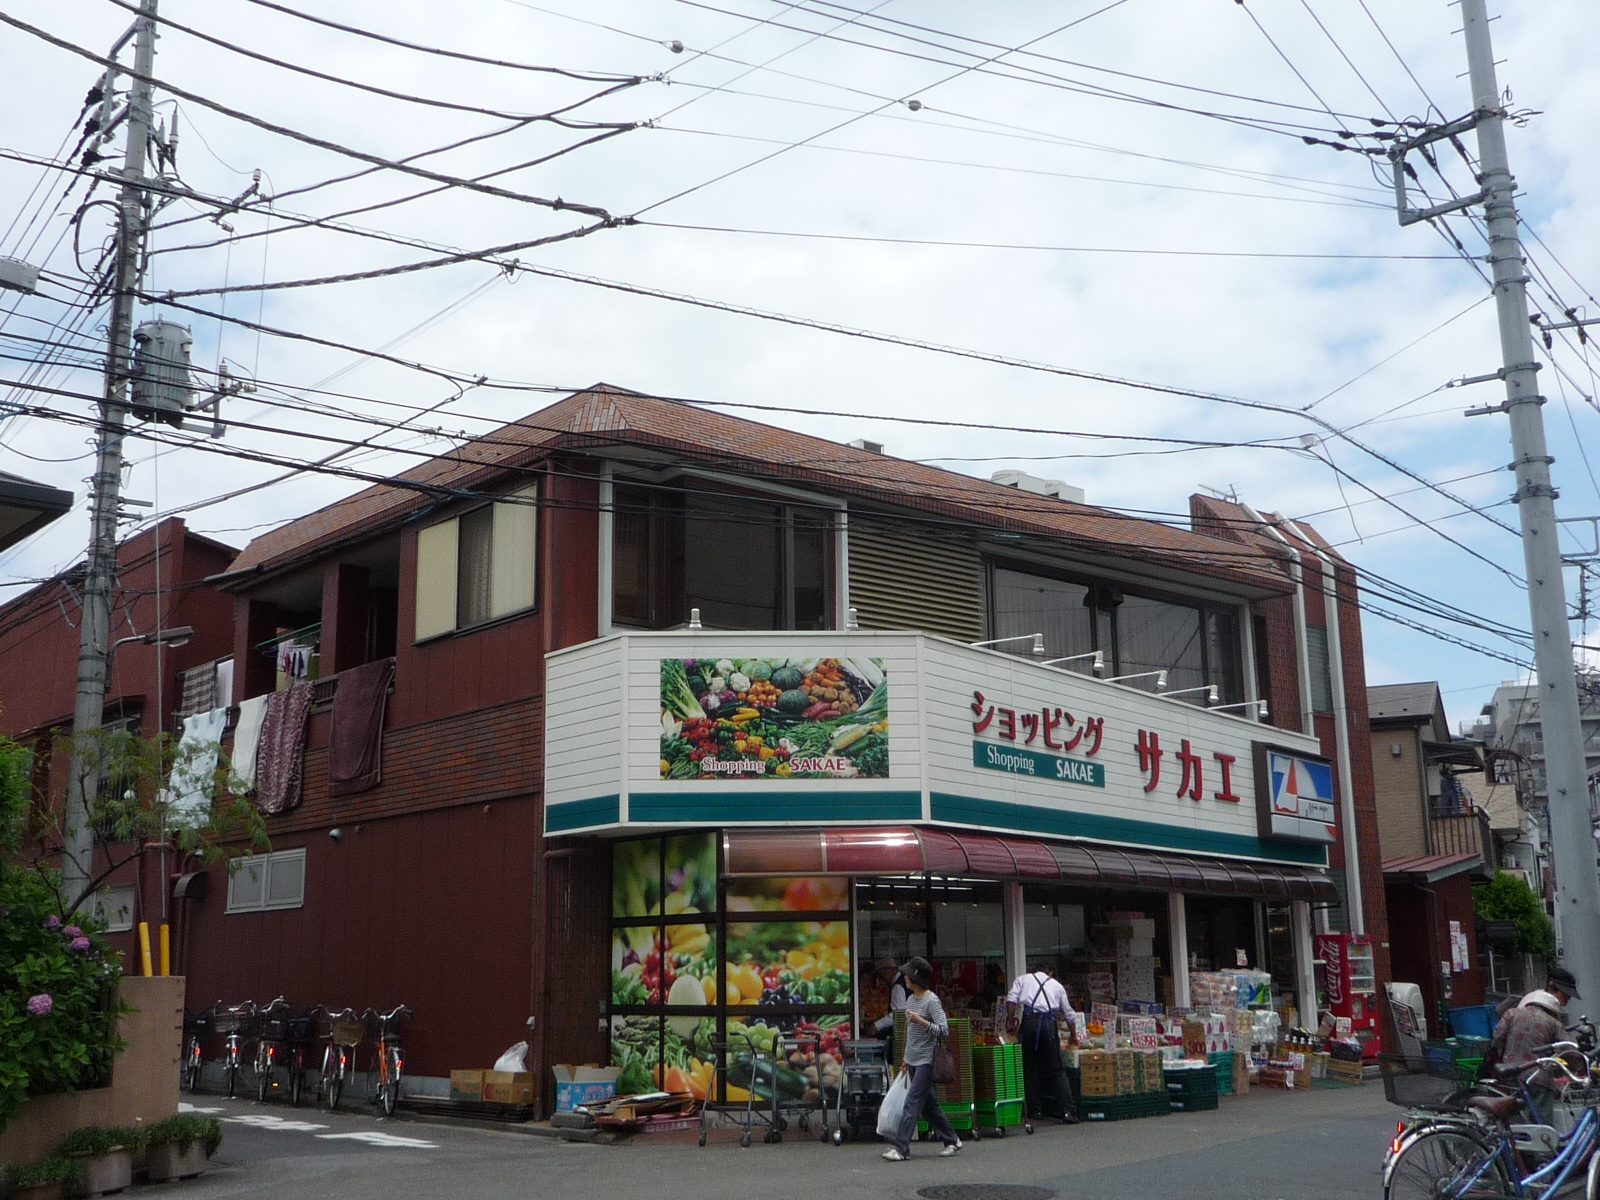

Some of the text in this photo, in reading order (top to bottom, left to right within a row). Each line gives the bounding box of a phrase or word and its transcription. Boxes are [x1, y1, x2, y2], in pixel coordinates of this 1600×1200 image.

[702, 757, 846, 774] Shopping SAKAE
[971, 691, 1240, 803] ショッピング サカエ
[987, 745, 1095, 782] Shopping SAKAE
